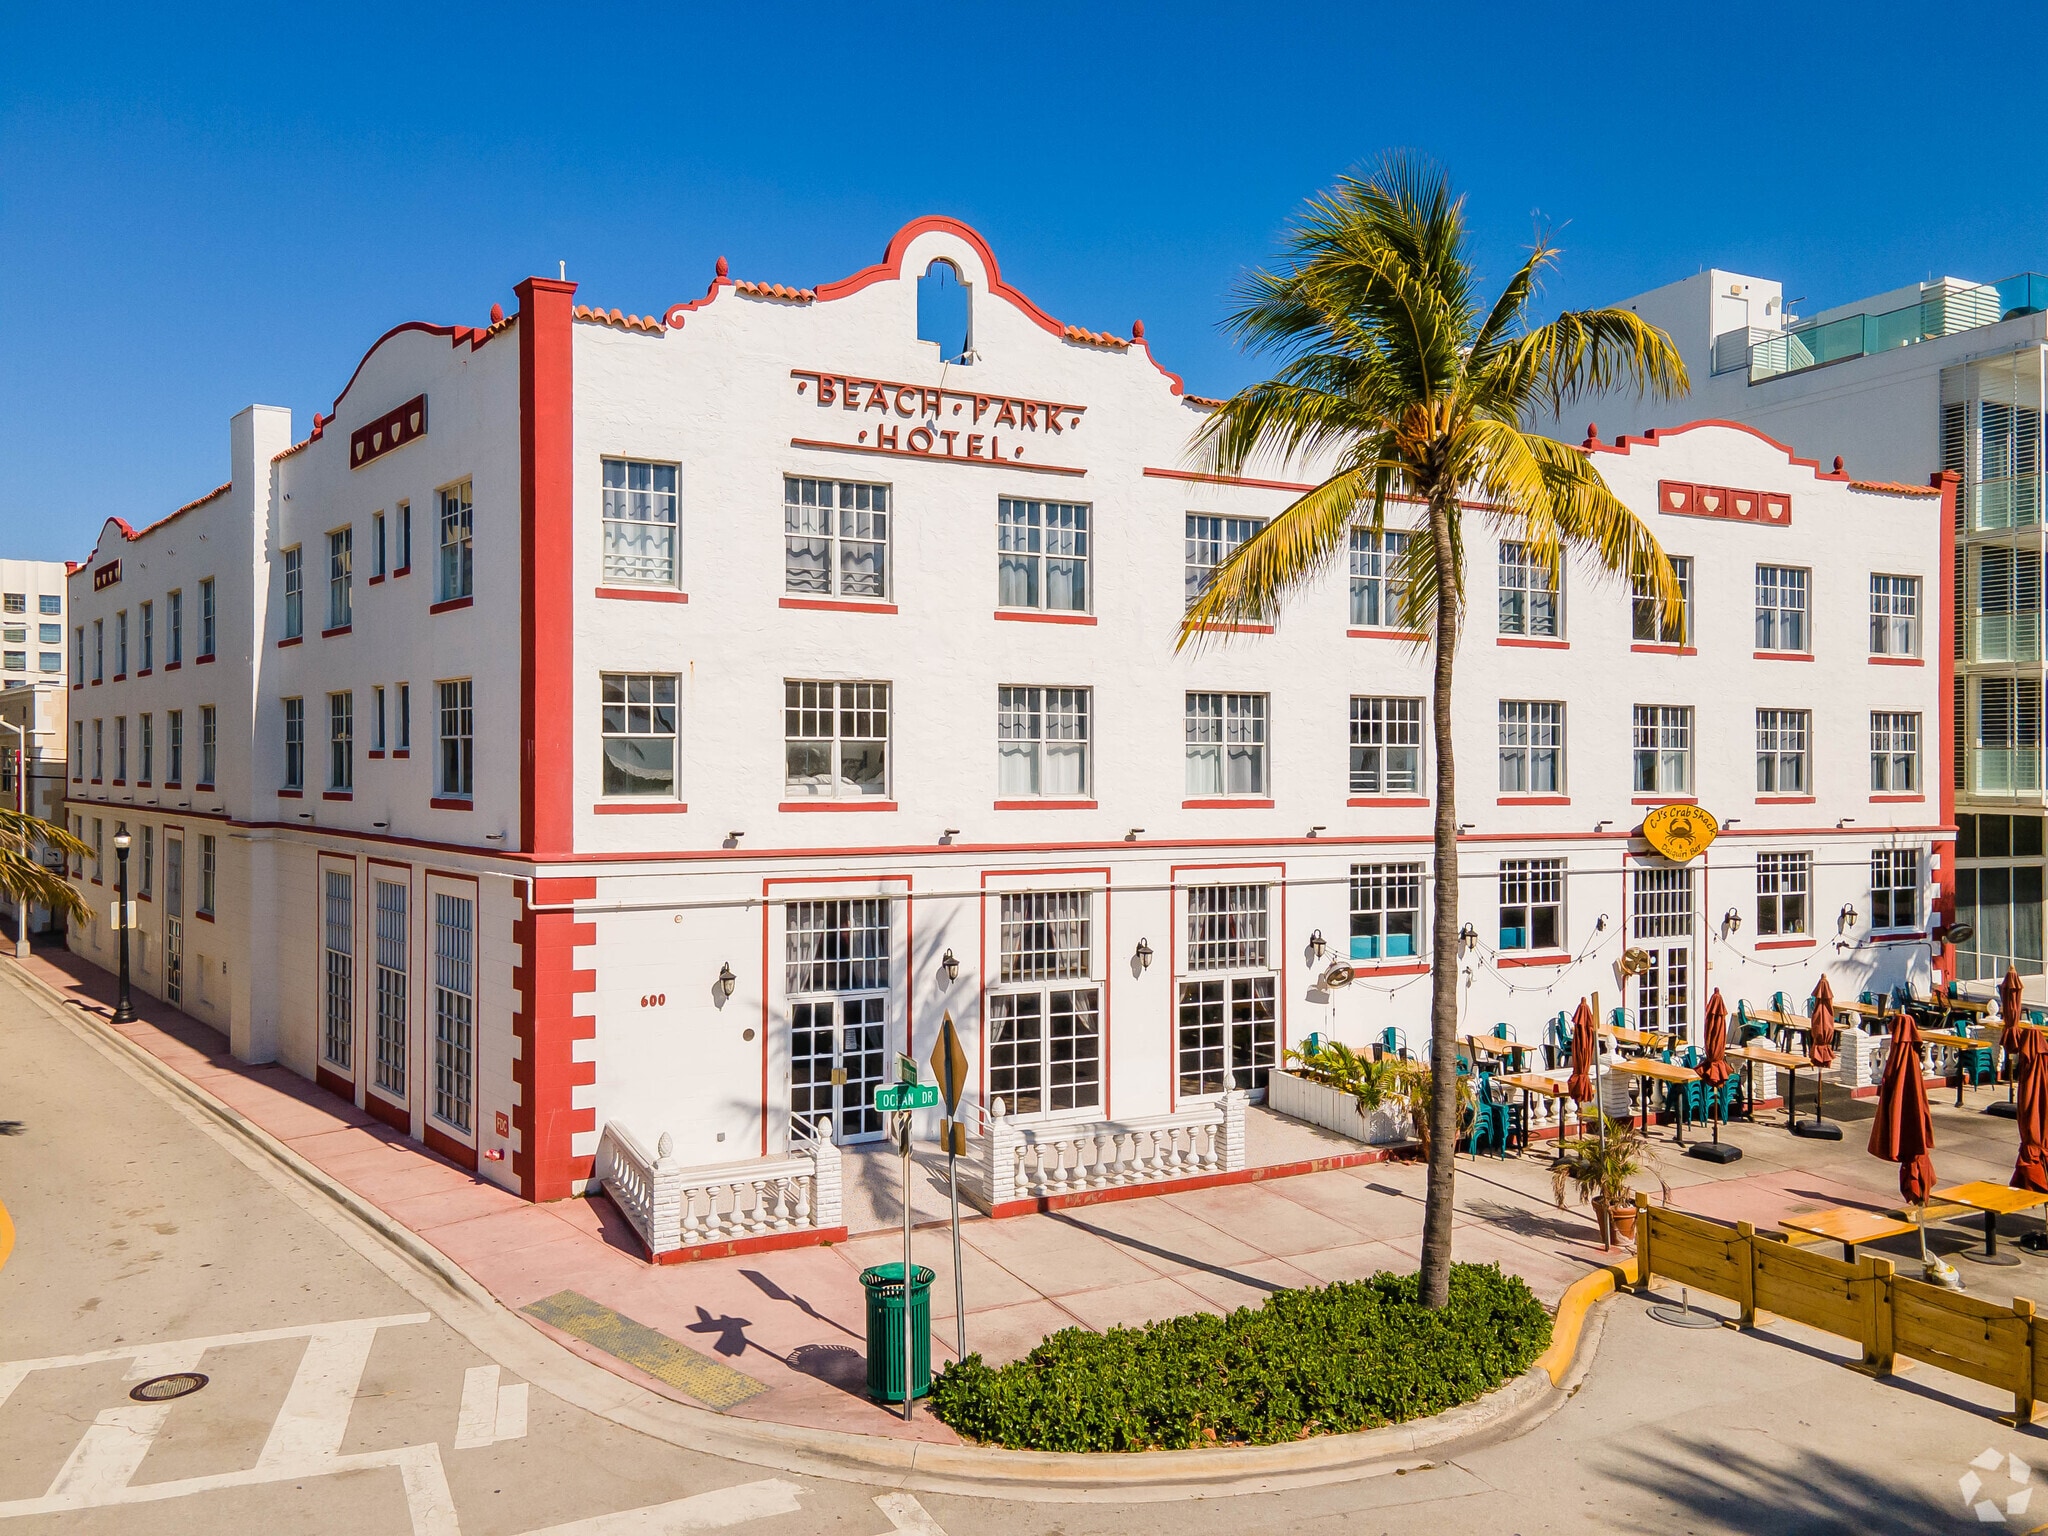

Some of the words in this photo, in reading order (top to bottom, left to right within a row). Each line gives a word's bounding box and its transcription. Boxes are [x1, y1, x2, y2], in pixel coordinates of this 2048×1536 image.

[817, 374, 942, 416] BEACH
[973, 394, 1066, 431] PARK
[877, 423, 1007, 460] HOTEL
[1669, 807, 1691, 818] Crab
[1692, 809, 1716, 836] Shack
[1690, 843, 1701, 855] Bar
[640, 993, 666, 1008] 600
[883, 1093, 914, 1107] OCEAN
[922, 1090, 933, 1104] DR
[496, 1117, 508, 1133] FDC
